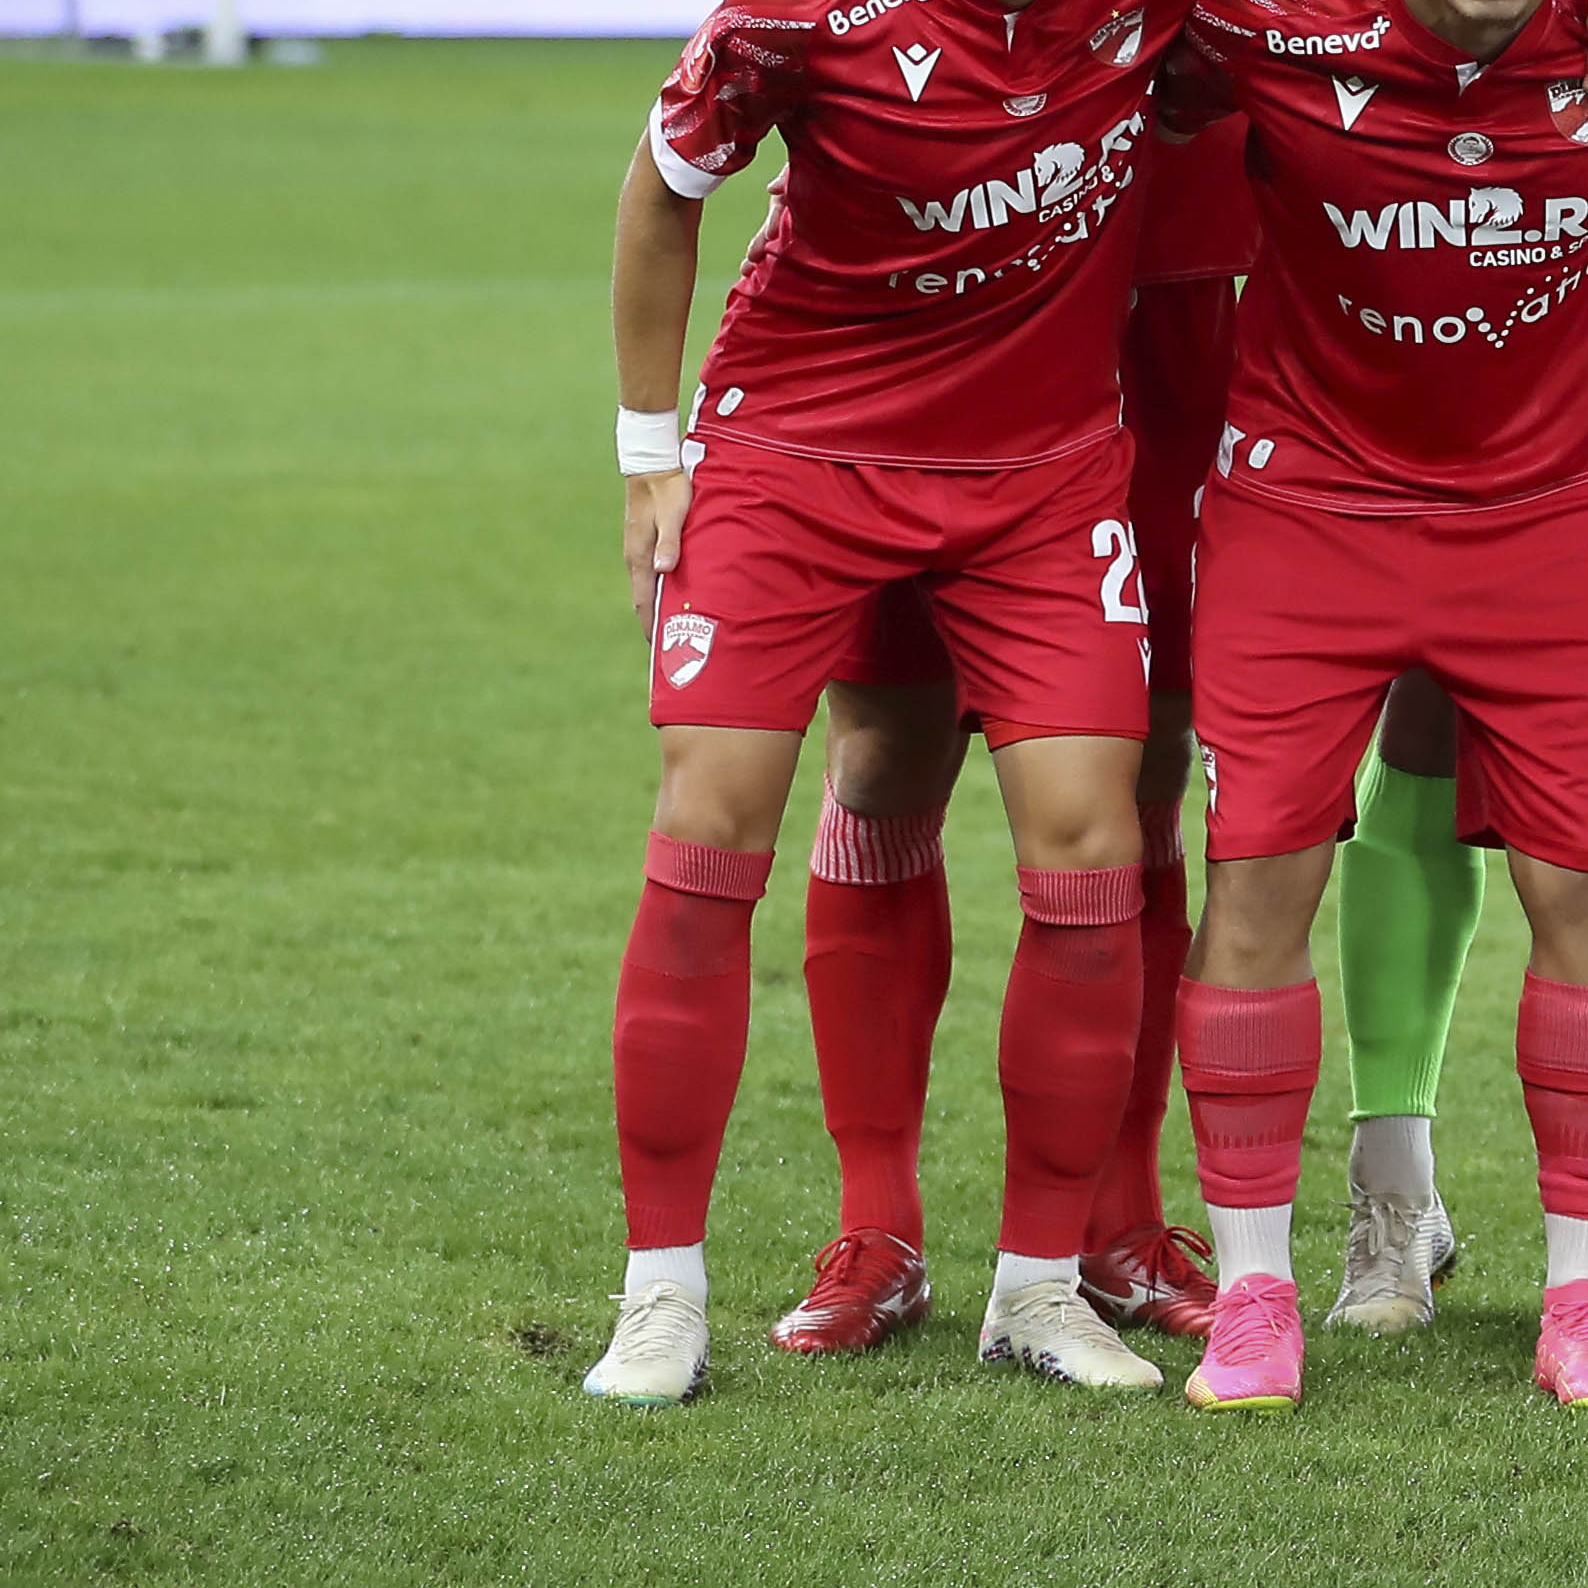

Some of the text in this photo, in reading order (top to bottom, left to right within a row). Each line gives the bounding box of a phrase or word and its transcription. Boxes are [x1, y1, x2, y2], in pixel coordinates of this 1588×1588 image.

[1266, 26, 1382, 56] Beneva
[1470, 245, 1564, 268] CASINO &
[1091, 518, 1150, 624] 2
